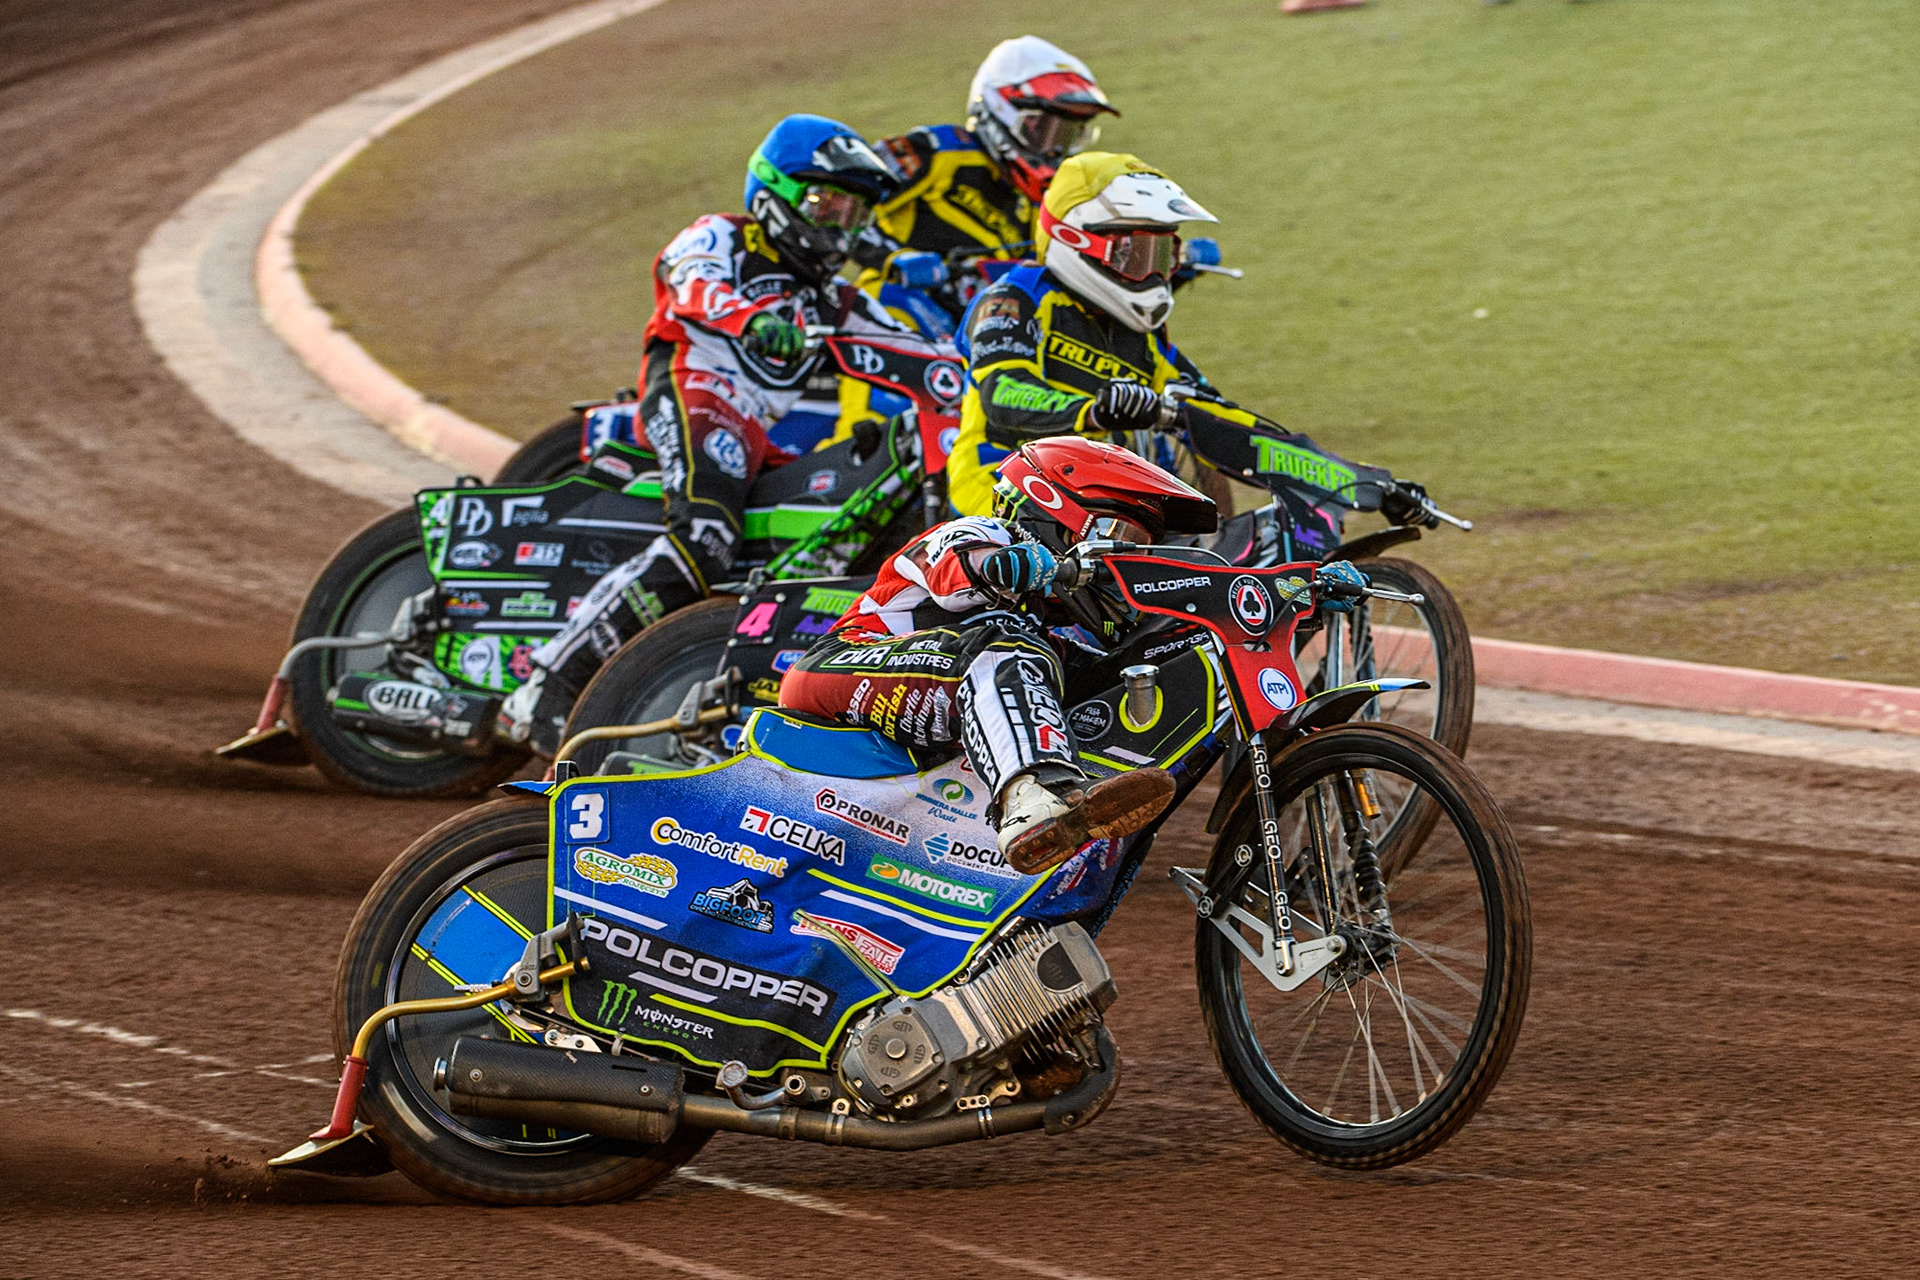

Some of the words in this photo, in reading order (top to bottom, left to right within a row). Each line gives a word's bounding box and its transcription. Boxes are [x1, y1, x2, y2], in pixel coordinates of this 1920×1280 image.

[1049, 335, 1095, 367] TRU
[1134, 576, 1211, 594] POLCOPPER
[737, 603, 778, 637] 4
[830, 646, 891, 665] DVR
[1266, 682, 1289, 696] ATPI
[870, 693, 888, 727] Bill
[900, 688, 922, 733] Charlie
[1254, 750, 1271, 788] GEO
[569, 793, 604, 839] 3
[836, 799, 910, 839] PRONAR
[927, 806, 957, 823] Waste
[949, 805, 978, 820] MALLEE
[653, 818, 786, 876] ComfortRent
[769, 818, 844, 864] CELKA
[1264, 821, 1281, 859] GEO
[582, 852, 667, 886] AGROMIX
[946, 856, 984, 869] DOCUMENT
[986, 864, 1020, 878] SOLUTIONS
[899, 869, 989, 908] MOTOREX
[693, 893, 766, 924] BIGFOOT
[1275, 891, 1292, 930] GEO
[581, 919, 828, 1016] POLCOPPER
[635, 1005, 714, 1040] MONSTER
[643, 1021, 699, 1041] ENERGY
